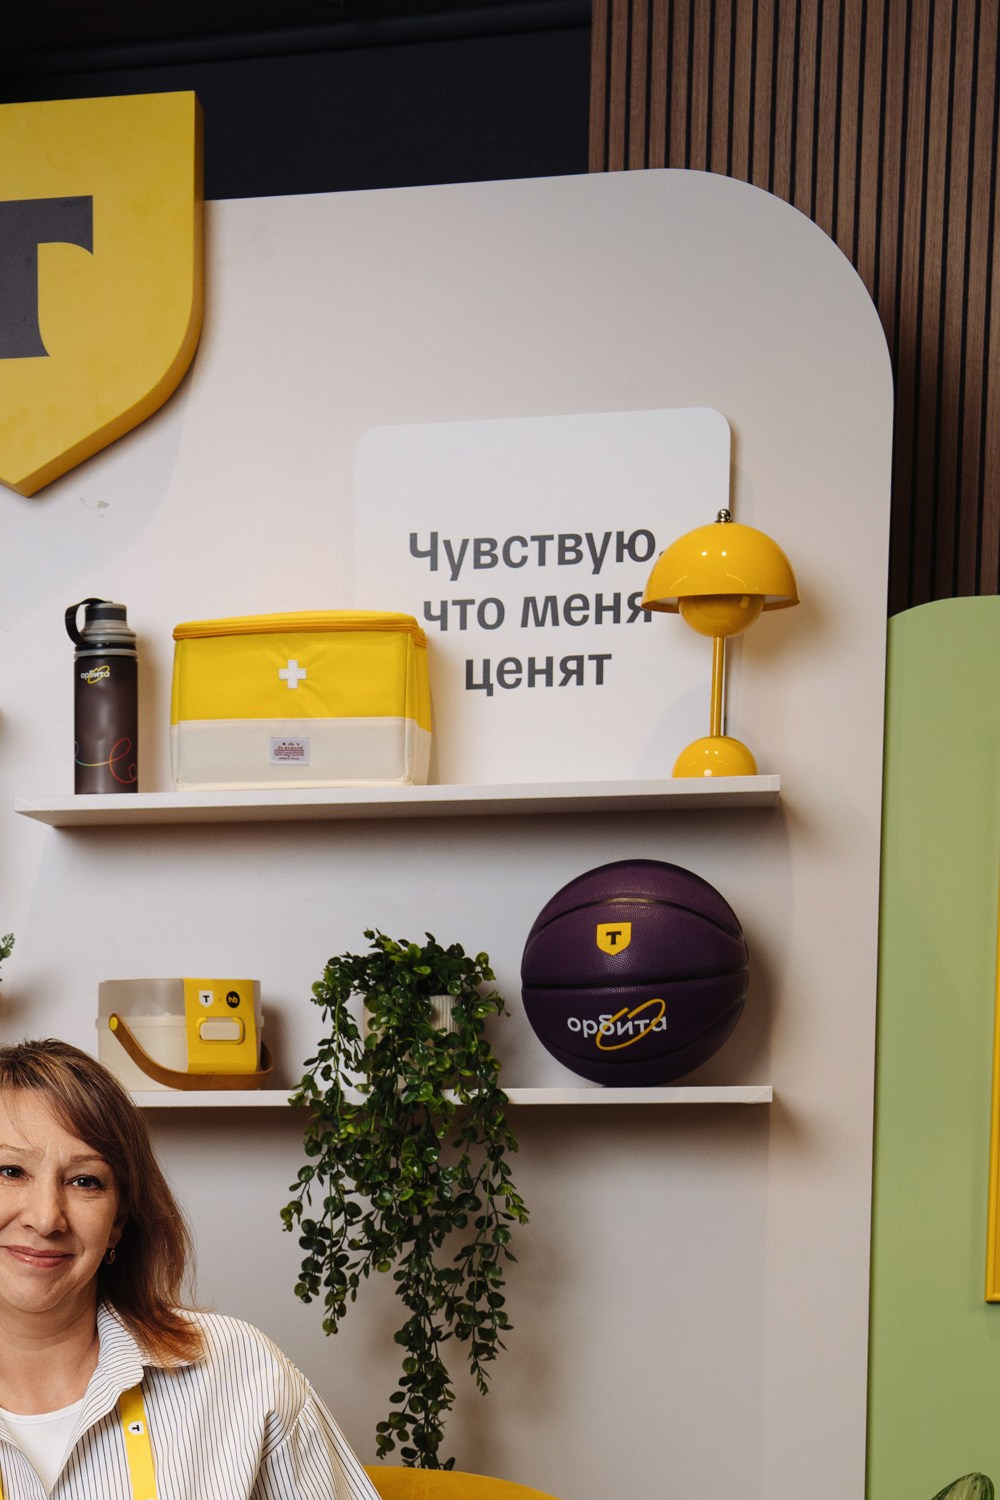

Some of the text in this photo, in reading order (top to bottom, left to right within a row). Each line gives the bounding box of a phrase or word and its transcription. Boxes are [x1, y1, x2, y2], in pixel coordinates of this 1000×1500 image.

[409, 528, 664, 581] Чувствую
[423, 591, 652, 631] что меня
[465, 653, 612, 697] ценят
[605, 931, 622, 945] Т
[567, 1014, 667, 1038] орбита
